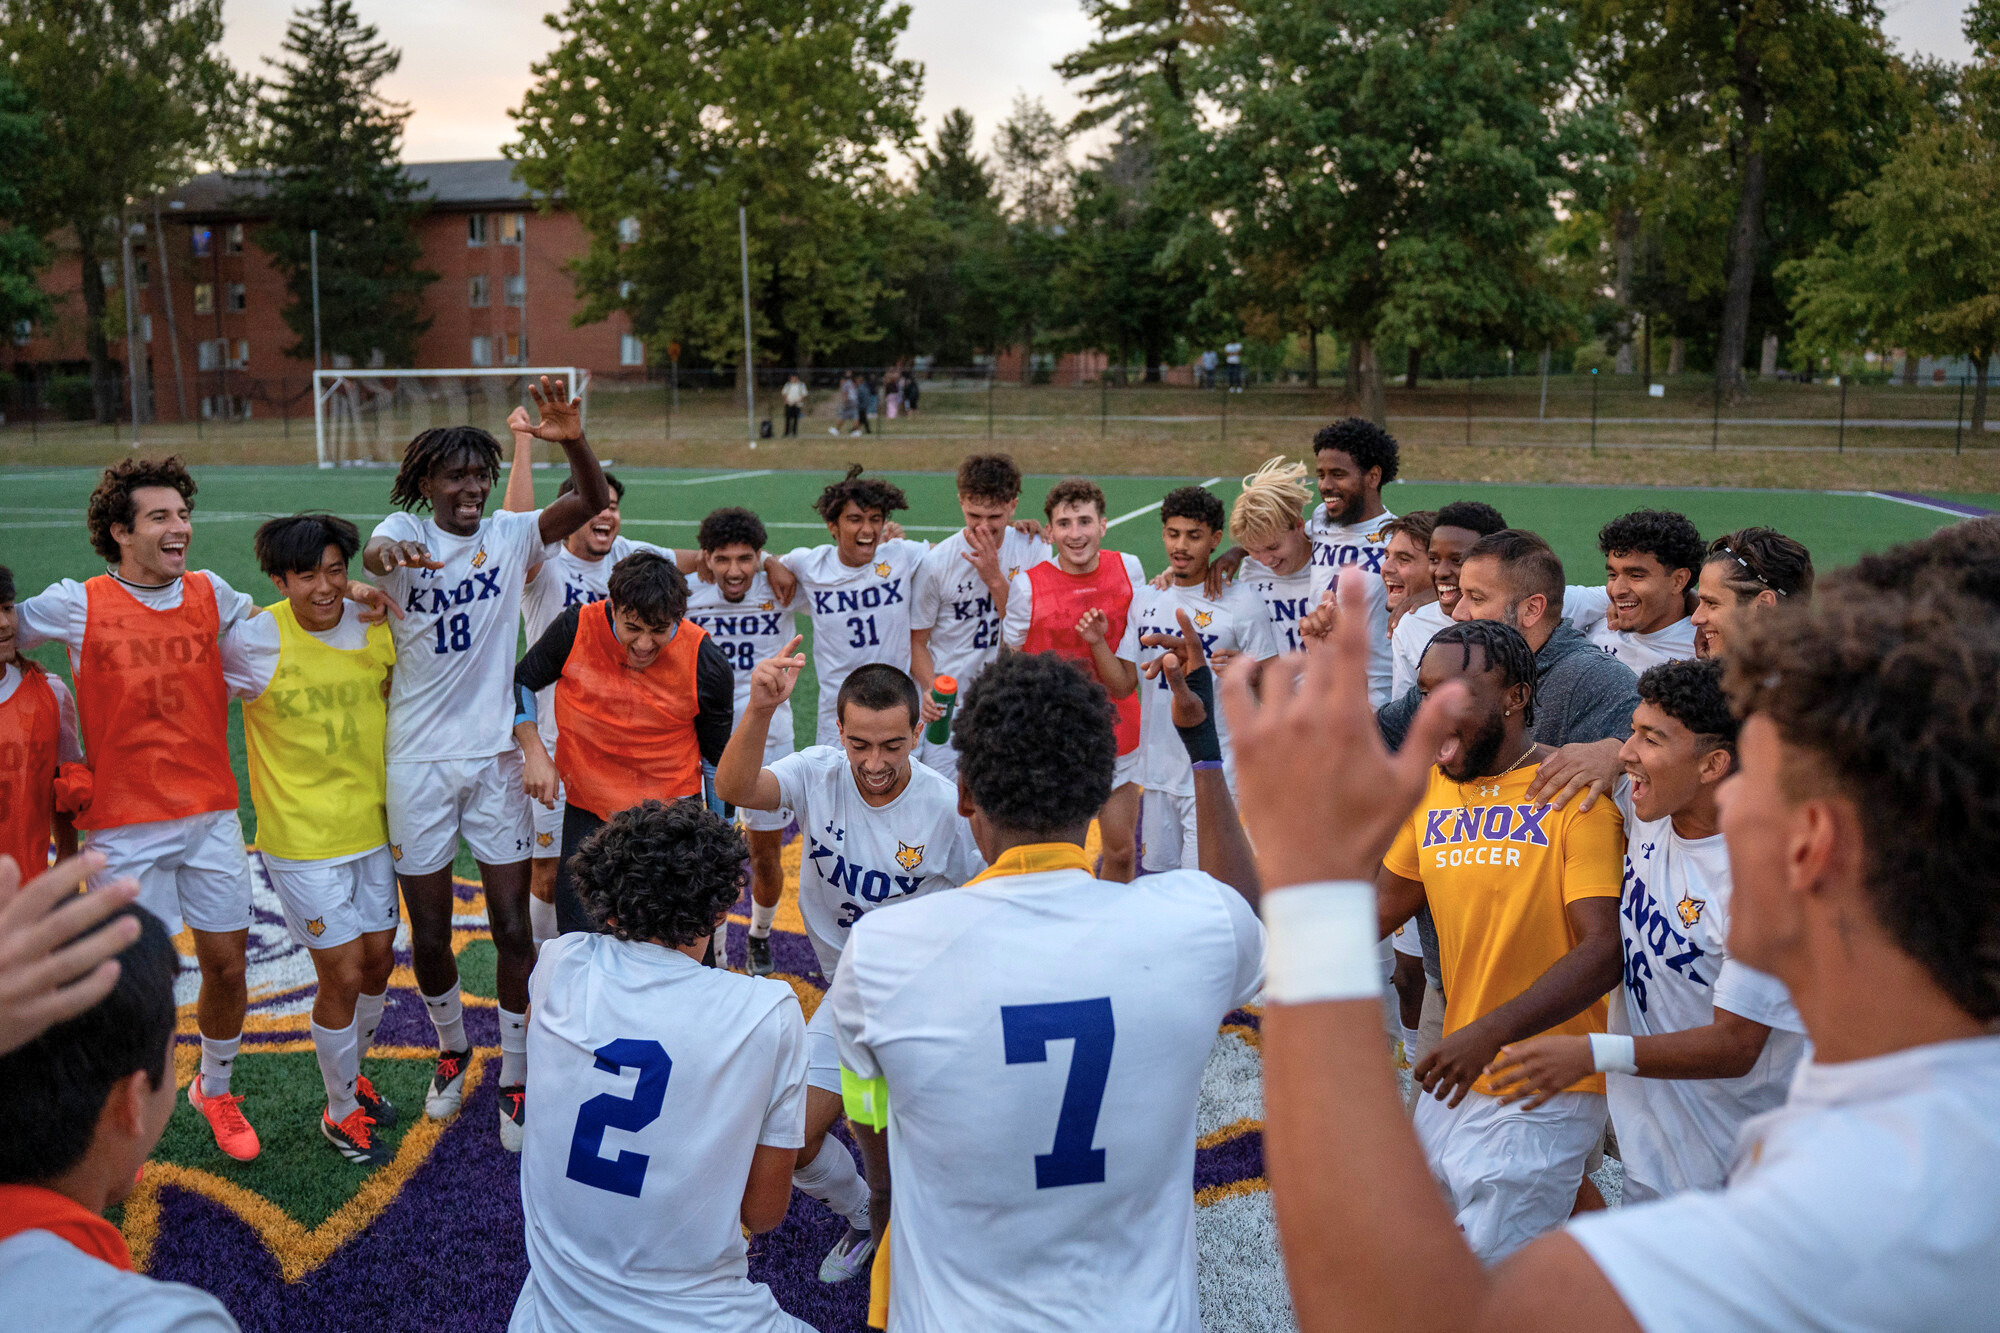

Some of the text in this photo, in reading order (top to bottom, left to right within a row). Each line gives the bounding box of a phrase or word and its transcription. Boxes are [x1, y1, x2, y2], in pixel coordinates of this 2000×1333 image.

[1311, 541, 1385, 574] KNOX
[406, 566, 501, 614] KNOX
[814, 578, 903, 615] KNOX
[952, 592, 998, 620] KN
[434, 612, 471, 654] 18
[689, 612, 781, 637] KNOX
[847, 614, 880, 648] 31
[973, 617, 1000, 649] 22
[90, 632, 215, 672] KNOX
[721, 641, 754, 671] 28
[143, 672, 185, 719] 15
[321, 711, 361, 756] 14
[1422, 803, 1552, 849] KNOX
[808, 836, 926, 903] KNOX
[1436, 847, 1520, 868] SOCCER
[837, 902, 865, 928] 3
[1001, 997, 1115, 1189] 7
[566, 1037, 673, 1198] 2
